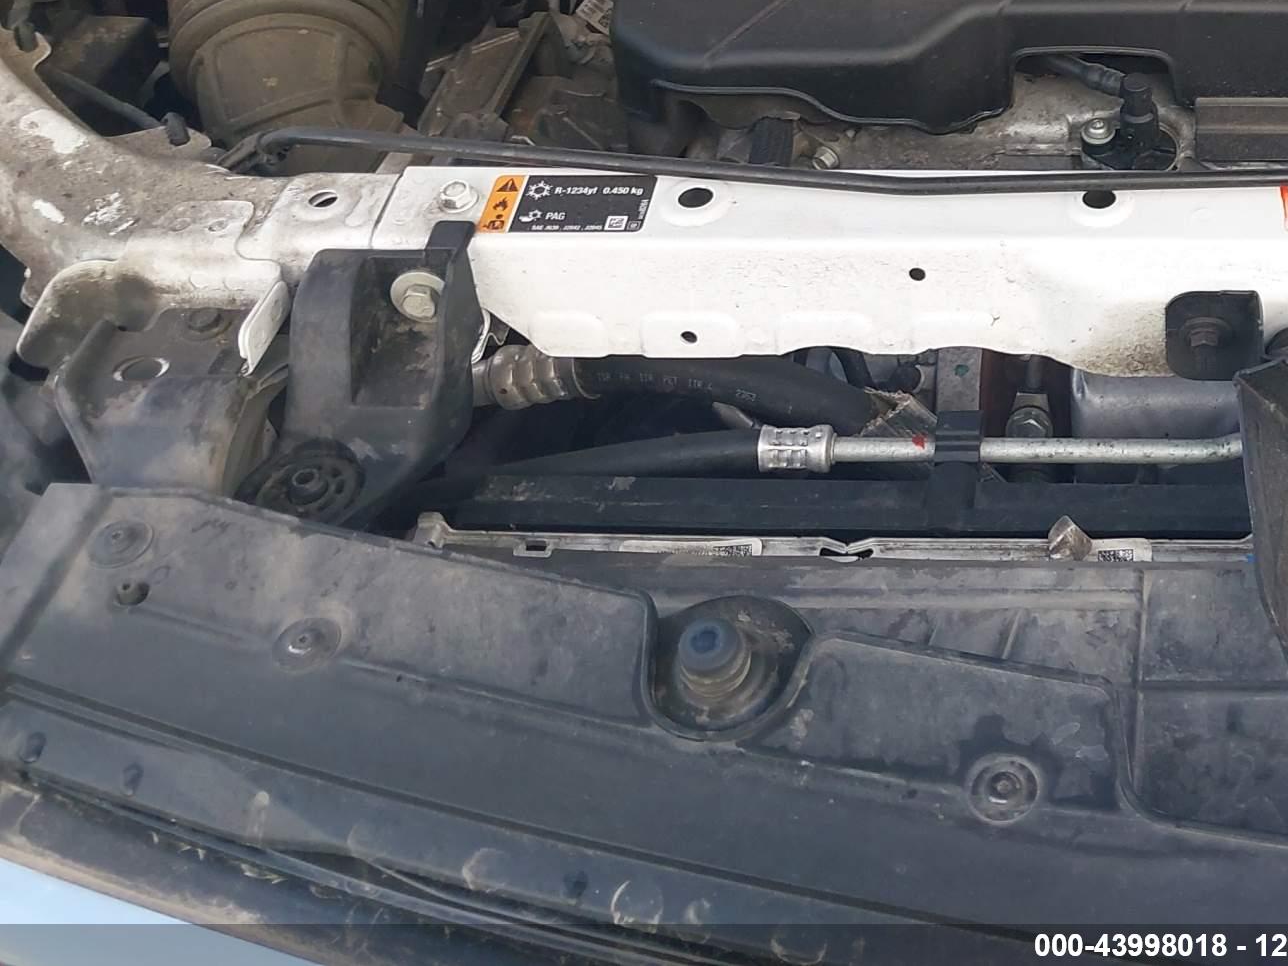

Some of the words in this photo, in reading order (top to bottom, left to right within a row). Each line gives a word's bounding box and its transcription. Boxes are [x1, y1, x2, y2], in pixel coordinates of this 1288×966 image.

[554, 187, 598, 195] R-1234yf
[602, 186, 629, 194] 0.450
[630, 187, 644, 196] kg
[545, 212, 566, 221] PAG
